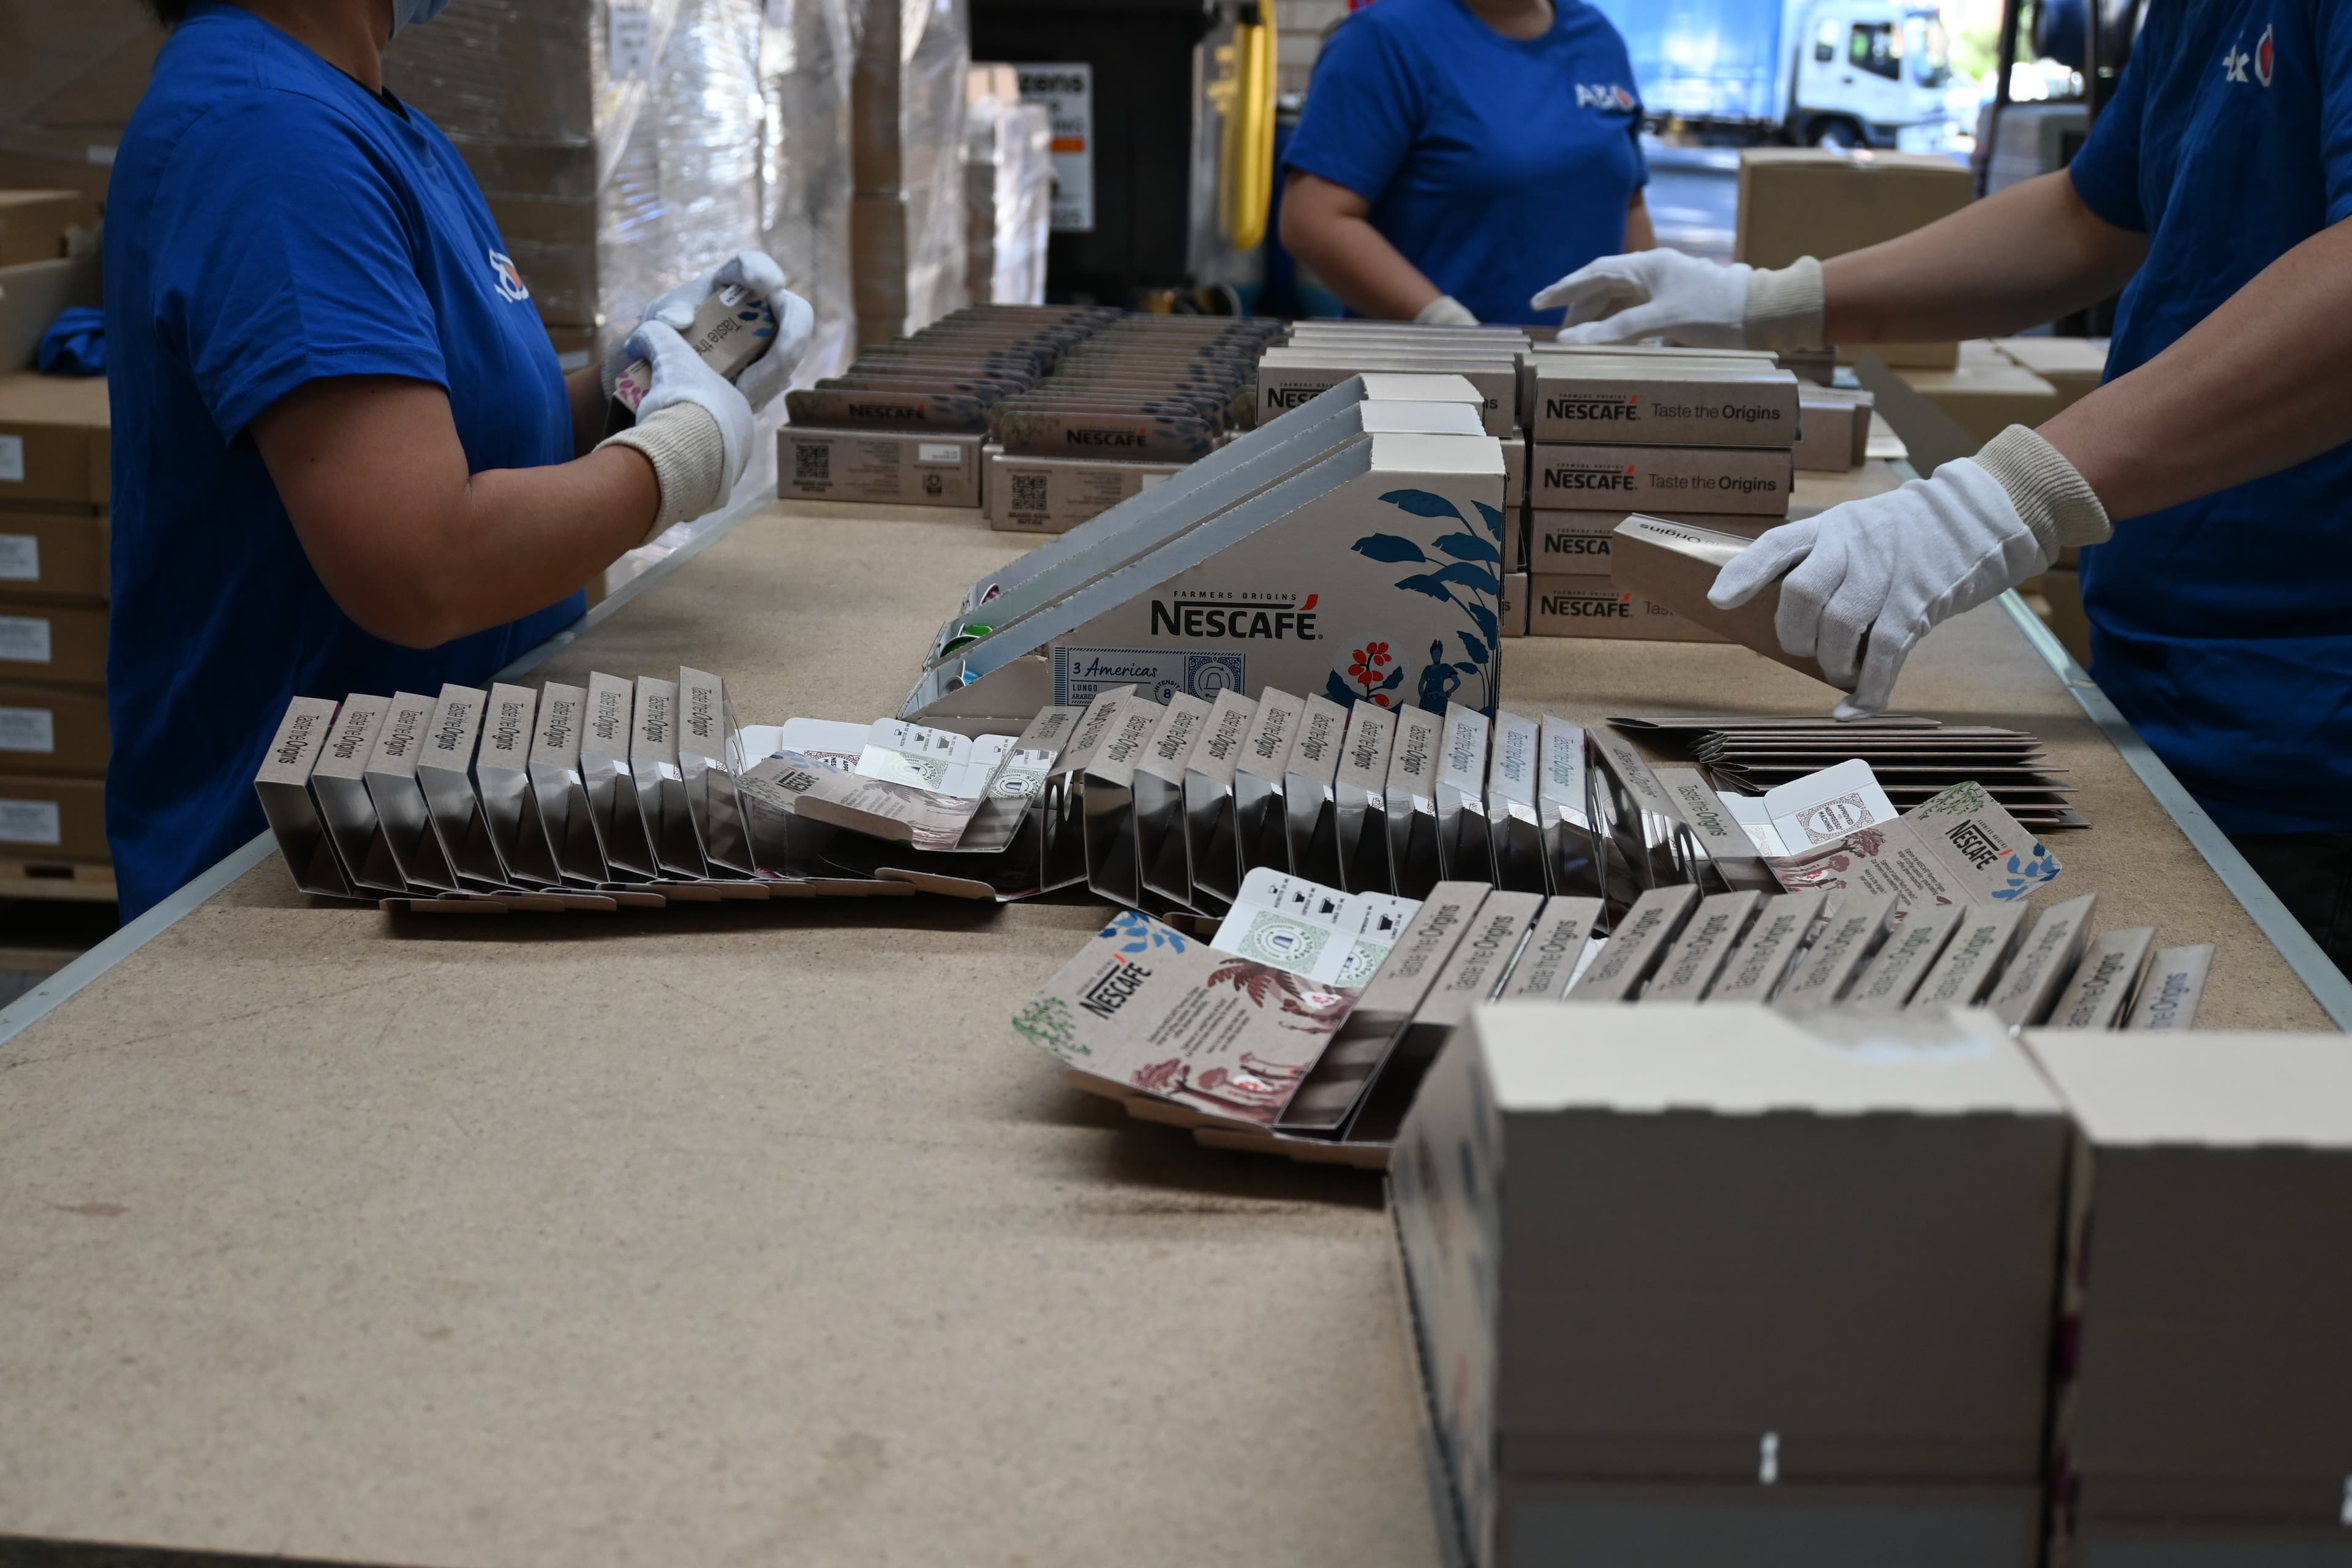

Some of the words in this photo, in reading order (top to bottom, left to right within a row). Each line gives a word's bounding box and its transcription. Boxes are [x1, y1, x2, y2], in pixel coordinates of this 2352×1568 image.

[707, 317, 742, 343] Taste
[849, 403, 925, 420] NESCAFÉ
[1547, 395, 1638, 420] NESCAFÉ
[1652, 403, 1692, 418] Taste
[1695, 404, 1719, 418] the
[1722, 404, 1781, 423] Origins
[1066, 428, 1147, 447] NESCAFÉ
[1544, 465, 1634, 491] NESCAFÉ
[1649, 473, 1688, 489] Taste
[1692, 475, 1716, 489] the
[1719, 475, 1777, 494] Origins
[1639, 522, 1702, 545] Origins
[1174, 590, 1233, 599] FARMERS
[1242, 592, 1297, 601] ORIGINS
[1541, 592, 1631, 617] NESCAFÉ
[1152, 594, 1319, 641] NESCAFÉ
[1073, 662, 1081, 675] 3
[1085, 657, 1158, 679] Americas
[599, 690, 621, 706] Taste
[648, 695, 669, 710] Taste
[692, 686, 712, 703] Taste
[1164, 688, 1172, 699] 8
[397, 709, 423, 724] Taste
[447, 702, 472, 717] Taste
[500, 701, 524, 717] Taste
[552, 700, 575, 715] Taste
[598, 704, 619, 717] the
[647, 708, 668, 720] the
[692, 701, 712, 714] the
[1086, 701, 1116, 726] Origins
[1267, 707, 1291, 725] Taste
[292, 714, 320, 730] Taste
[348, 710, 375, 726] Taste
[443, 716, 467, 728] the
[499, 716, 521, 728] the
[550, 714, 572, 725] the
[592, 715, 619, 739] Origins
[687, 712, 713, 737] Origins
[1126, 714, 1153, 731] Taste
[1173, 710, 1199, 728] Taste
[1222, 709, 1247, 727] Taste
[1311, 712, 1335, 729] Taste
[288, 729, 312, 740] the
[344, 725, 368, 736] the
[393, 723, 417, 734] the
[542, 724, 571, 748] Origins
[641, 718, 668, 743] Origins
[1081, 723, 1104, 736] the
[1120, 728, 1143, 741] the
[1168, 724, 1191, 737] the
[1218, 723, 1240, 737] the
[1263, 722, 1285, 735] the
[1309, 726, 1329, 739] the
[1360, 720, 1384, 737] Taste
[1409, 724, 1431, 742] Taste
[1455, 722, 1477, 740] Taste
[332, 735, 364, 758] Origins
[383, 733, 414, 756] Origins
[434, 726, 465, 750] Origins
[491, 726, 520, 750] Origins
[1069, 734, 1098, 754] Taste
[1156, 734, 1187, 760] Origins
[1207, 733, 1237, 760] Origins
[1254, 732, 1283, 759] Origins
[1358, 734, 1379, 747] the
[1406, 739, 1428, 752] the
[1454, 736, 1475, 750] the
[1506, 729, 1528, 748] Taste
[1553, 734, 1574, 752] Taste
[276, 740, 309, 764] Origins
[1107, 738, 1139, 763] Origins
[1300, 736, 1329, 761] Origins
[1350, 744, 1378, 770] Origins
[1505, 745, 1523, 758] the
[1553, 749, 1573, 763] the
[1399, 749, 1427, 775] Origins
[1447, 746, 1474, 772] Origins
[1499, 755, 1526, 782] Origins
[1548, 760, 1574, 786] Origins
[1676, 784, 1702, 801] Taste
[1687, 801, 1710, 812] the
[1837, 804, 1854, 825] APPROVED
[1695, 812, 1727, 836] Origins
[1818, 811, 1834, 832] MACHINES
[1945, 819, 2013, 871] NESCAFÉ
[1387, 954, 1428, 979] Taste
[1417, 903, 1460, 938] Origins
[1444, 966, 1485, 991] Taste
[1472, 916, 1514, 949] Origins
[1517, 969, 1555, 995] Taste
[1539, 920, 1578, 953] Origins
[1079, 954, 1153, 1020] NESCAFÉ
[2067, 1005, 2095, 1027] aste
